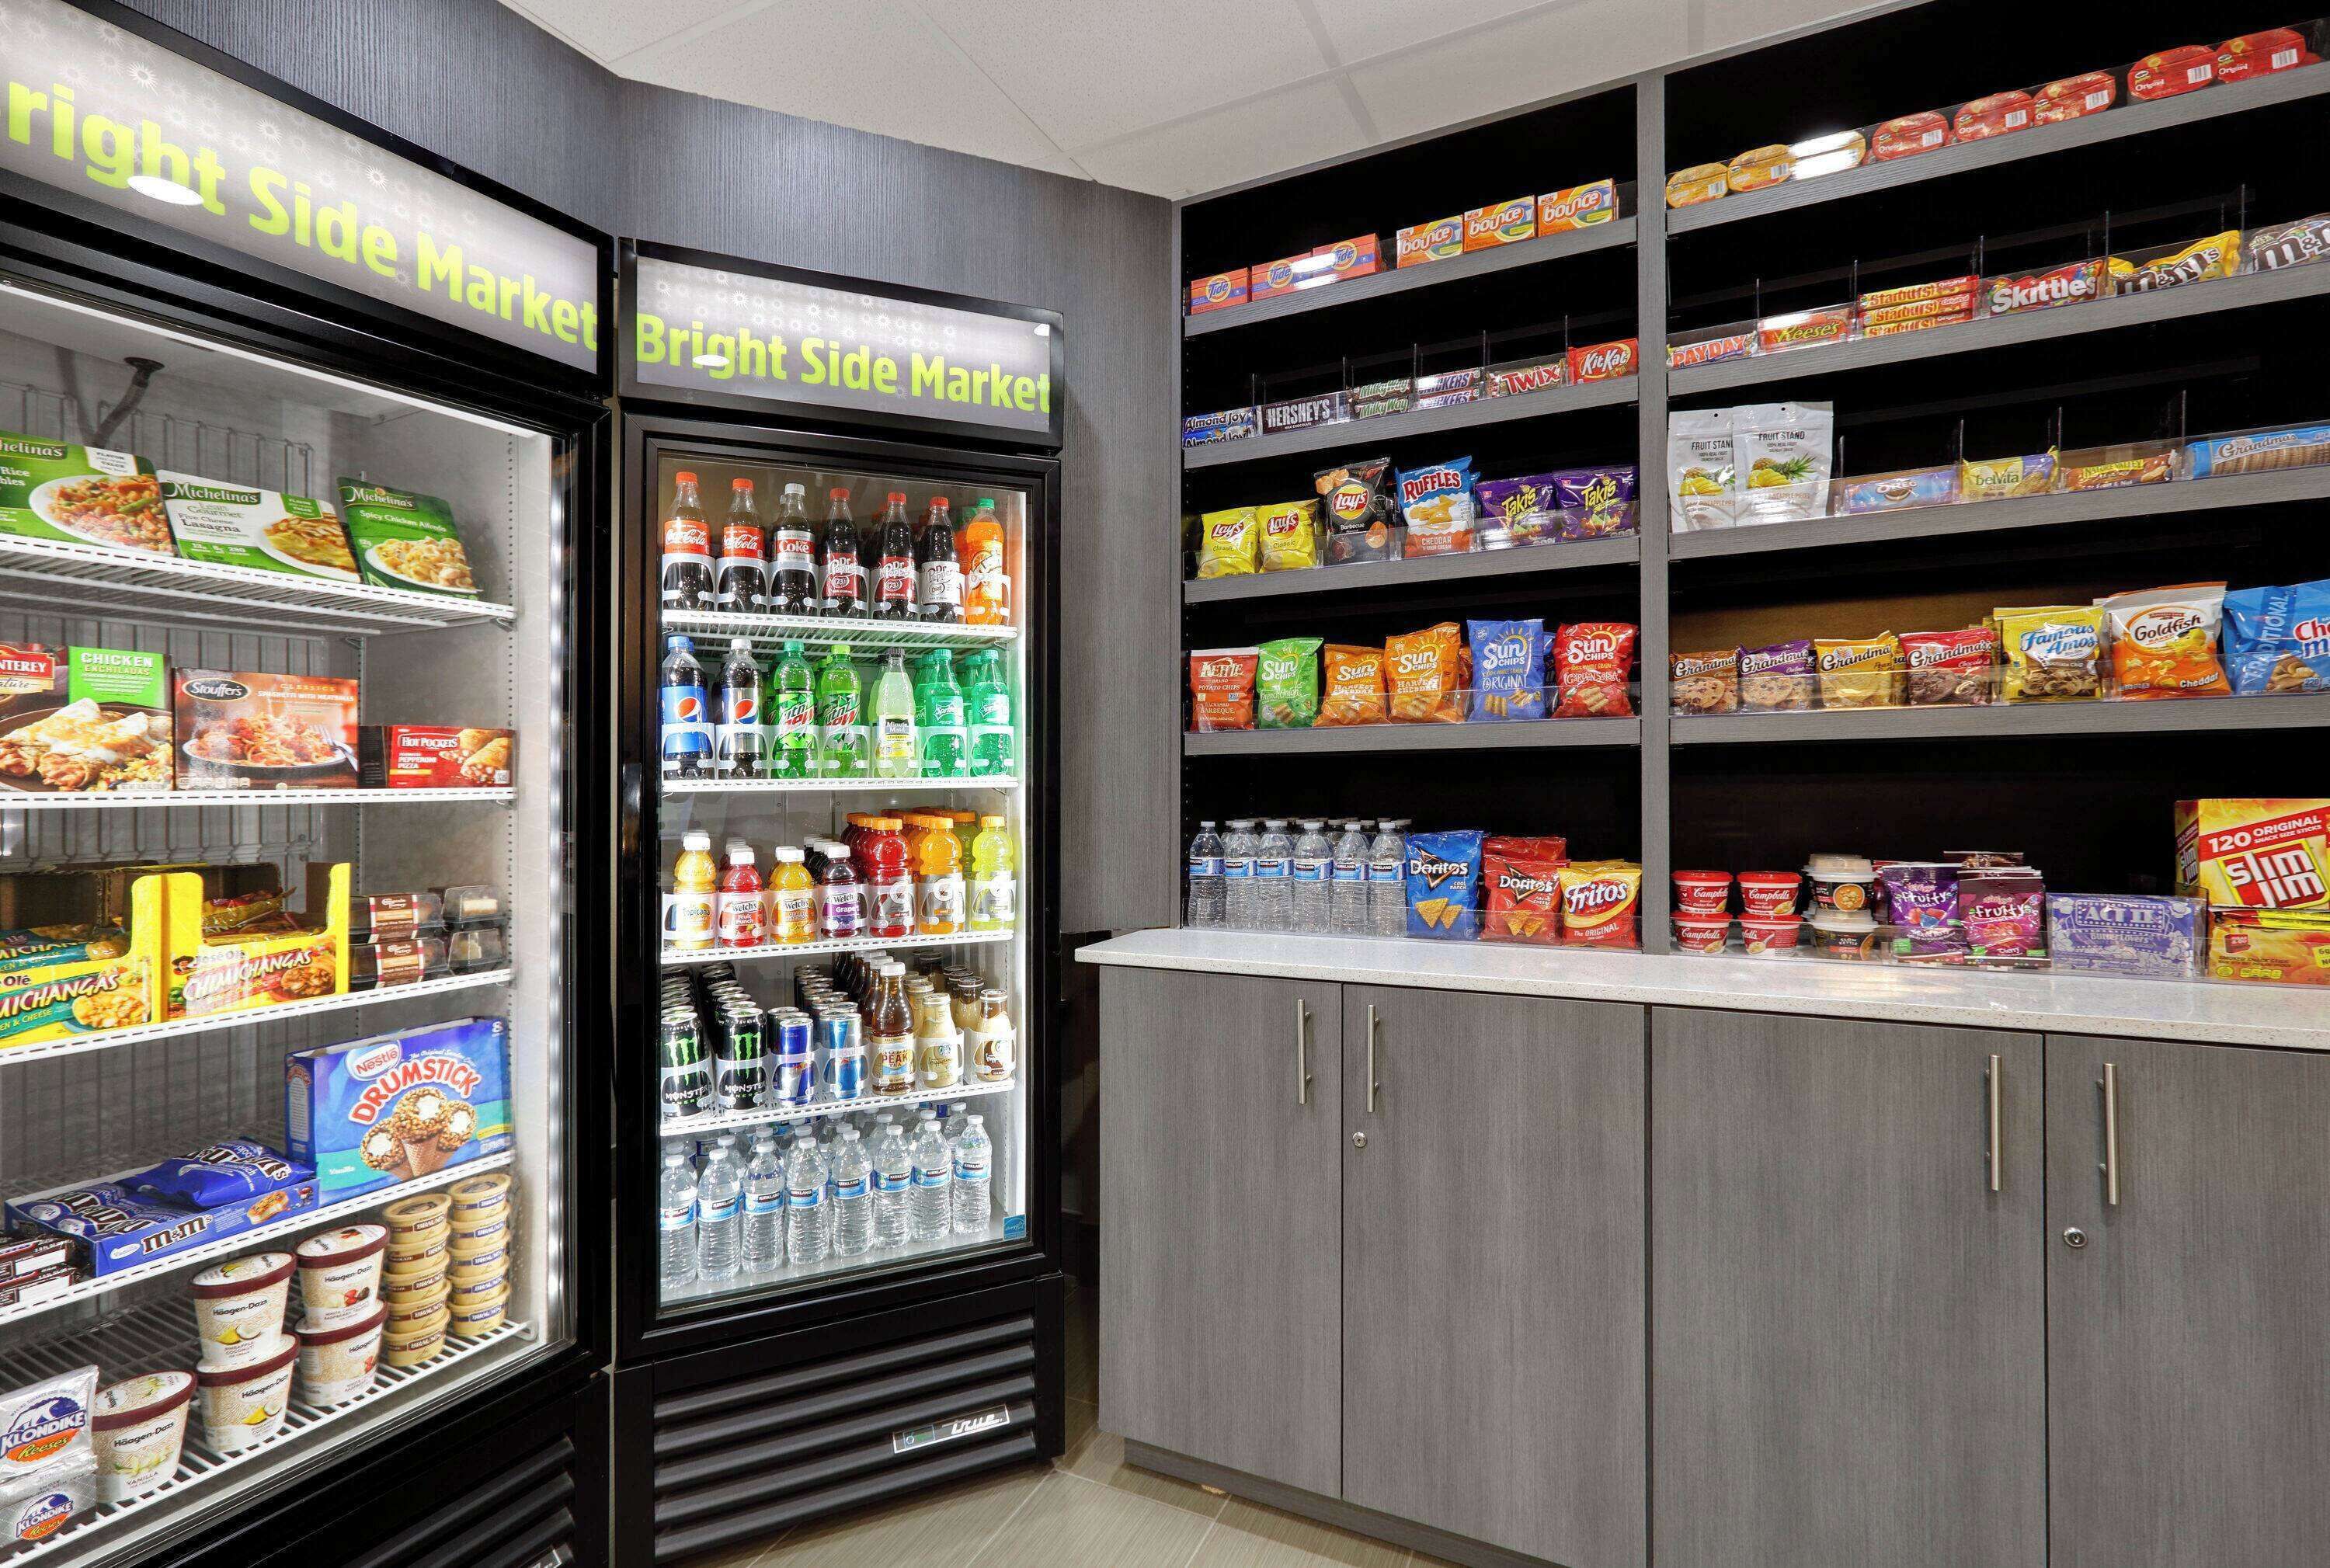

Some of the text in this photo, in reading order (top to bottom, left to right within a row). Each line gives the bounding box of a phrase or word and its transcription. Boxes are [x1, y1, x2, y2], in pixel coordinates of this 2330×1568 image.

[1543, 191, 1600, 224] bounce
[1470, 207, 1521, 236] bounce
[1401, 227, 1452, 256] bounce
[249, 166, 397, 278] Side
[417, 231, 597, 352] Market
[1271, 265, 1291, 284] Tide
[1208, 281, 1229, 298] Tide
[1990, 273, 2096, 314] Skittles
[1672, 334, 1747, 367] PAYDAY
[637, 312, 1050, 414] Bright Side Market
[1501, 366, 1560, 394] Twix
[1184, 412, 1250, 433] Almond Joy
[1268, 398, 1330, 428] HERSHEY'S
[1692, 441, 1712, 450] FRUIT
[1759, 430, 1805, 441] FRUIT STAND
[1403, 471, 1461, 502] RUFFLES
[1876, 479, 1917, 494] OREO
[1976, 471, 2019, 486] belVita
[164, 481, 259, 504] Michelina's
[346, 485, 414, 508] Michelina's
[1335, 494, 1368, 511] Lay's
[1581, 479, 1617, 511] Takis
[1502, 490, 1537, 518] Takis
[180, 519, 242, 534] Lasagna
[360, 509, 384, 521] Spicy
[384, 514, 418, 527] Chicken
[779, 540, 809, 553] Coke
[1421, 537, 1452, 545] CHEDDAR
[893, 561, 904, 569] Dr
[936, 565, 948, 573] Dr
[2020, 623, 2095, 652] Famous
[2135, 614, 2203, 641] Goldfish
[1483, 642, 1525, 669] Sun
[1568, 639, 1609, 664] Sun
[1584, 652, 1615, 660] CHIPS
[2047, 639, 2095, 655] Amos
[81, 652, 154, 668] CHICKEN
[1198, 659, 1244, 678] KETTLE
[1398, 651, 1435, 674] Sun
[1413, 662, 1437, 671] CHIPS
[1499, 657, 1525, 666] CHIPS
[84, 666, 150, 676] ENCHILADAS
[1262, 660, 1297, 681] Sun
[1337, 663, 1376, 681] Sun
[191, 682, 243, 697] Stouffer's
[2179, 673, 2219, 689] Cheddar
[2253, 815, 2322, 837] ORIGINAL
[2253, 824, 2323, 844] SNACK SIZE STICKS
[2208, 831, 2252, 854] 120
[1410, 860, 1468, 874] Doritos
[2226, 850, 2315, 887] Slim
[1500, 875, 1553, 893] Doritos
[2254, 871, 2326, 909] Jim
[785, 899, 809, 911] Welch's
[1566, 881, 1629, 913] Fritos
[2085, 906, 2156, 923] ACT II
[1584, 923, 1619, 937] ORIGINAL
[183, 950, 312, 1000] CHIMICHANGAS
[22, 1008, 54, 1022] CHEESE
[492, 1021, 503, 1034] 8
[355, 1045, 398, 1075] Nestlé
[882, 1054, 909, 1064] PEAK
[350, 1057, 482, 1123] DRUMSTICK
[142, 1213, 214, 1255] m&m's
[213, 1299, 268, 1316] Häagen-Dazs
[0, 1410, 87, 1458] KLONDIKE
[114, 1420, 175, 1448] Häagen-Dazs
[942, 1413, 1003, 1435] true
[124, 1472, 158, 1485] VANILLA
[16, 1500, 74, 1538] KLONDIKE
